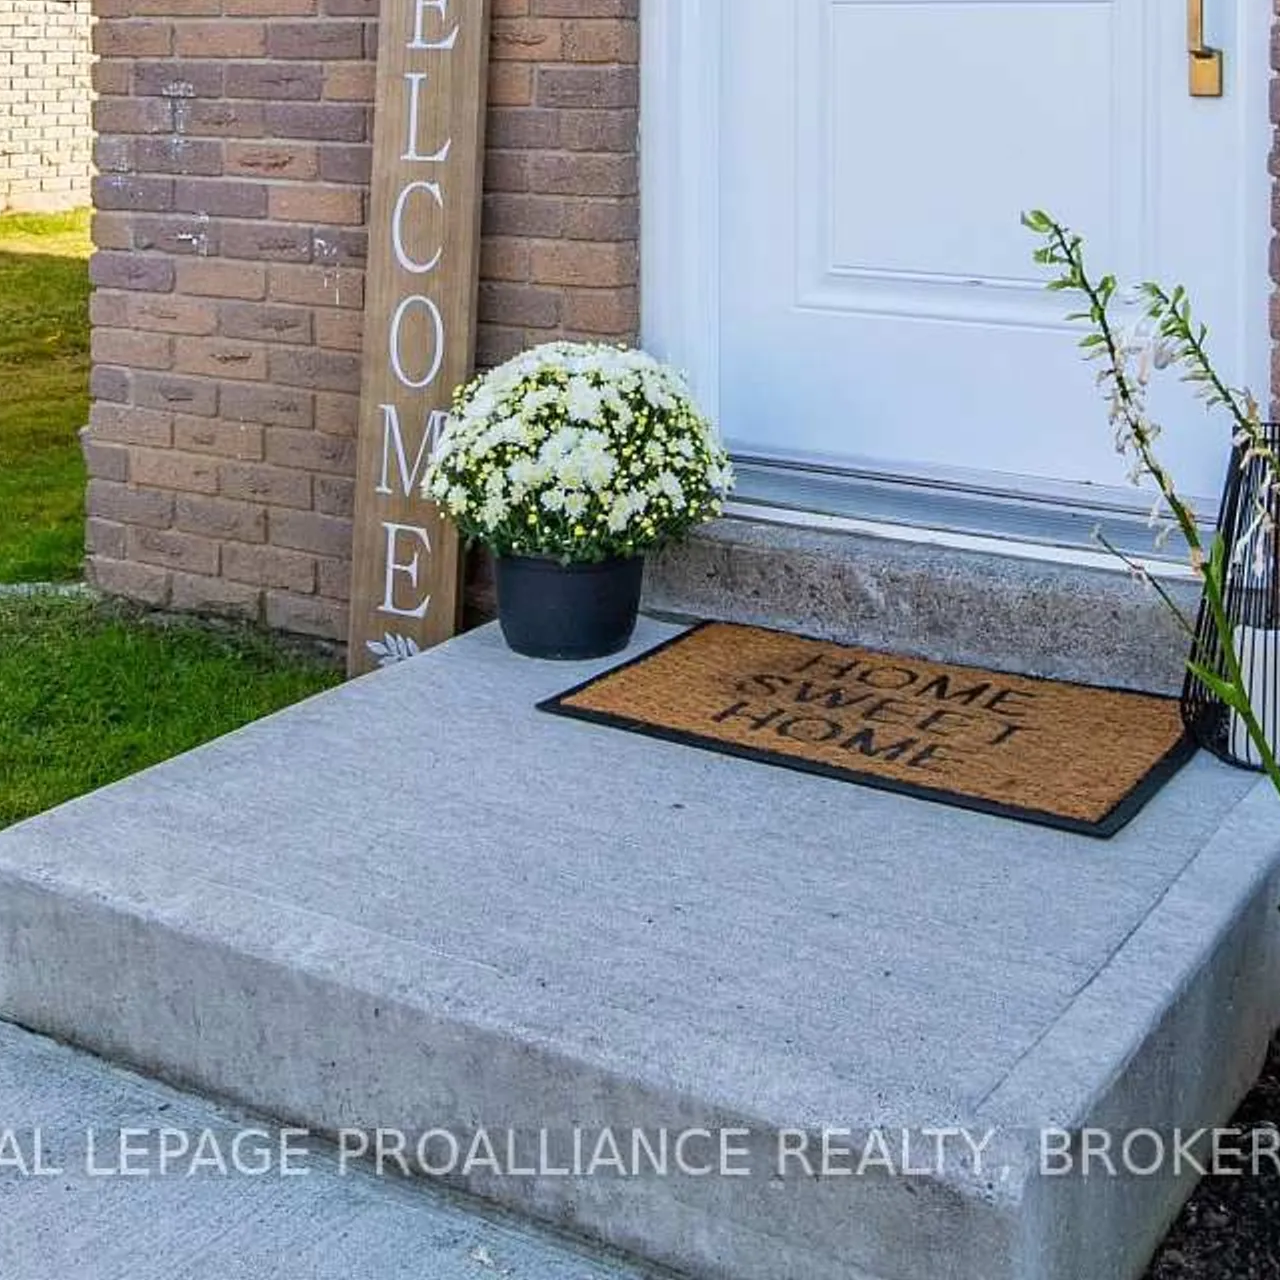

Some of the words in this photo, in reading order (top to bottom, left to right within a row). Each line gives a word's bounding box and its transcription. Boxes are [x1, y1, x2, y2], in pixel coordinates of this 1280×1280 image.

[735, 673, 1041, 745] SWEET
[796, 653, 1037, 717] HOME
[710, 700, 965, 770] HOME
